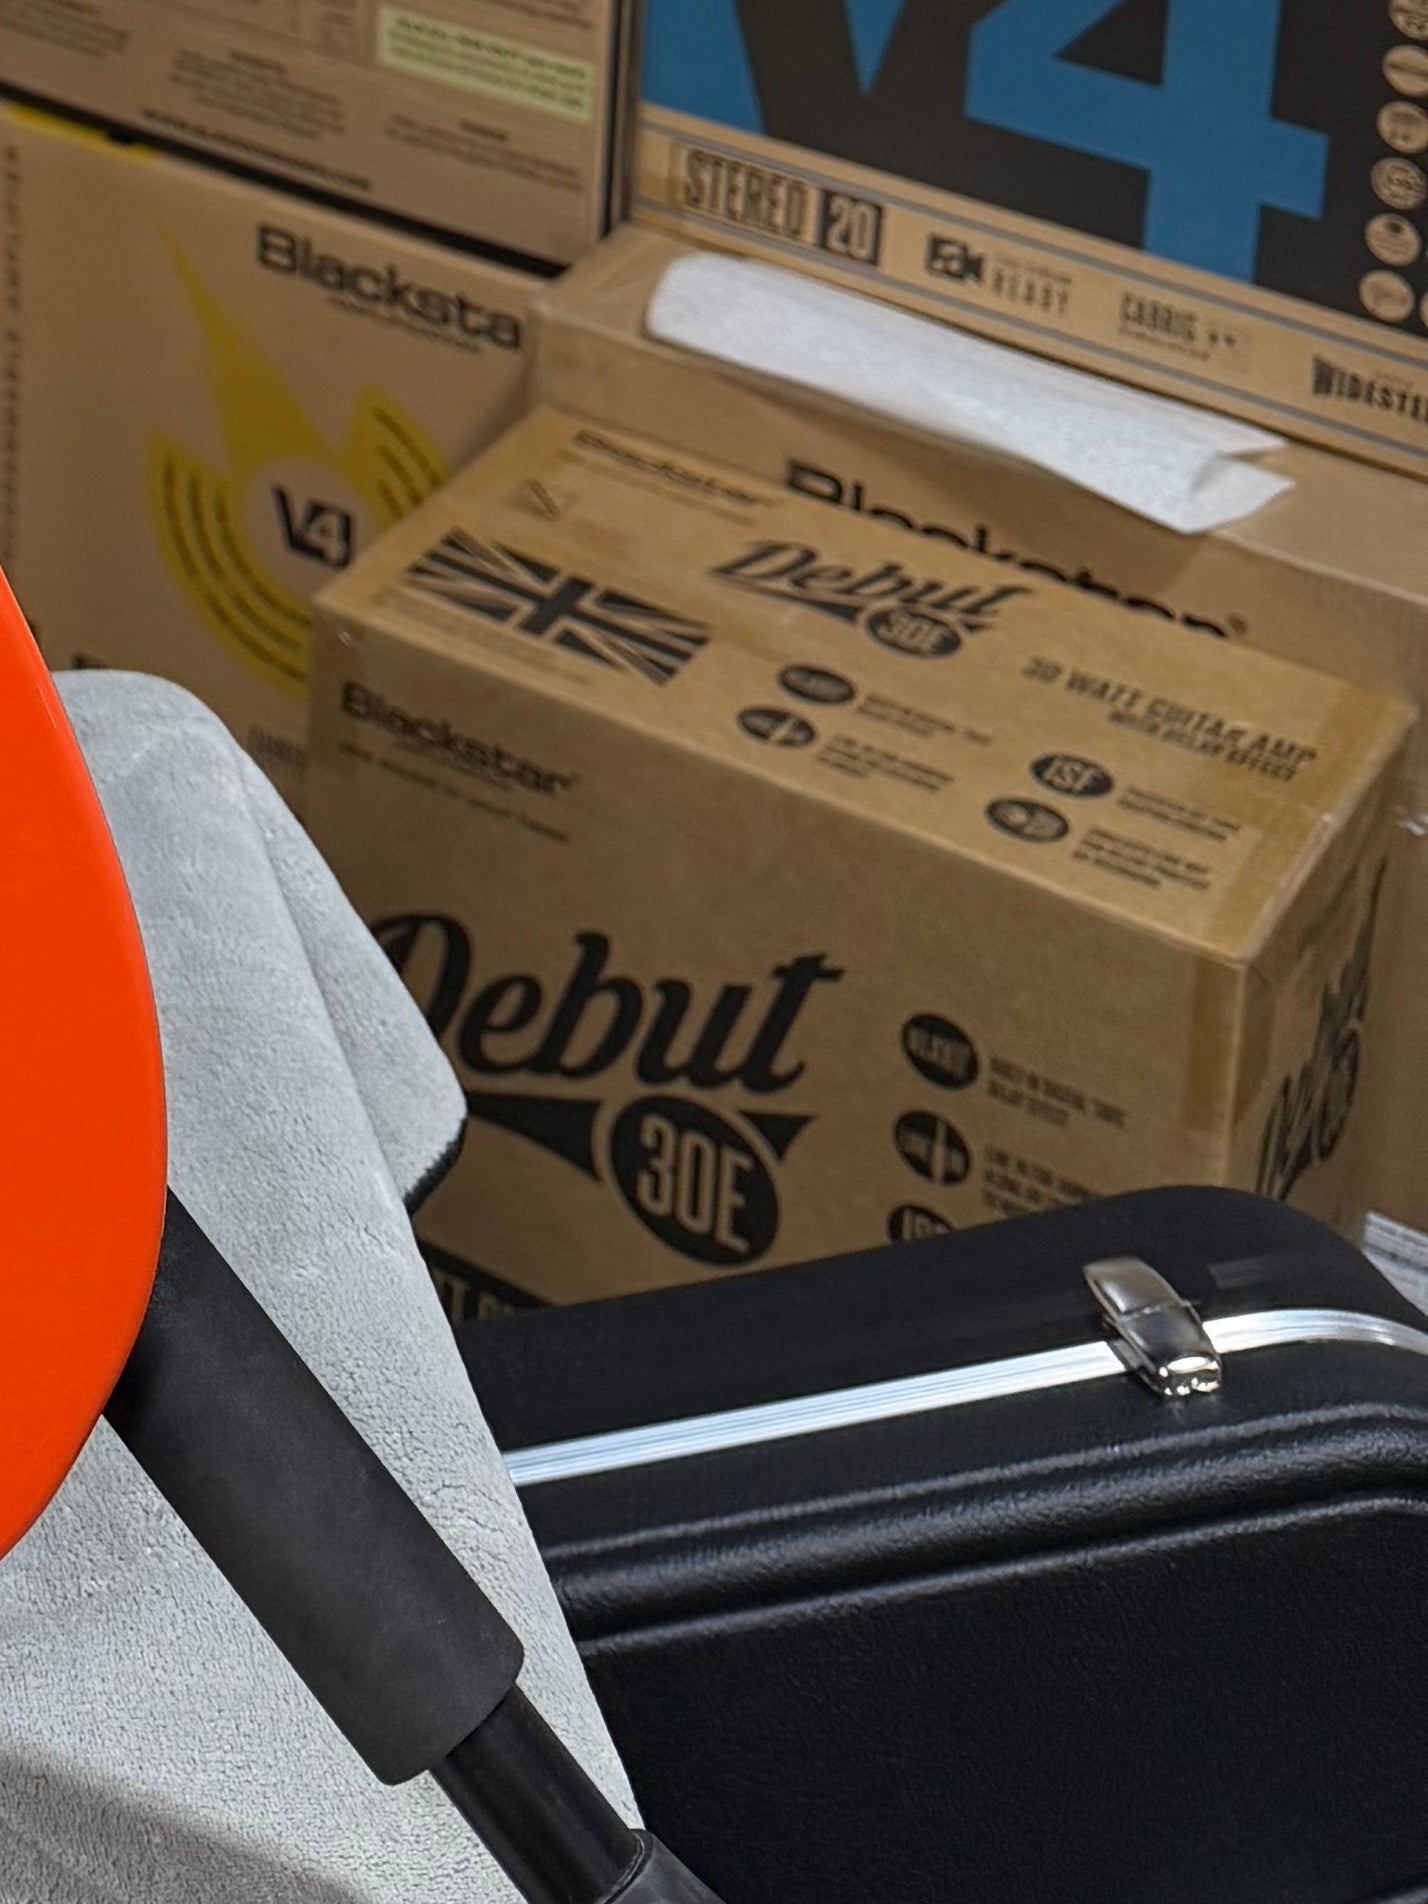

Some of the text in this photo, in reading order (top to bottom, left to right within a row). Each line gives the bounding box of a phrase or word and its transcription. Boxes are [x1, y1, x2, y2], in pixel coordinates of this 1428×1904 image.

[684, 147, 812, 240] STEREO
[257, 223, 523, 351] Blacksta
[369, 912, 844, 1094] Debut
[636, 1115, 753, 1254] 30E
